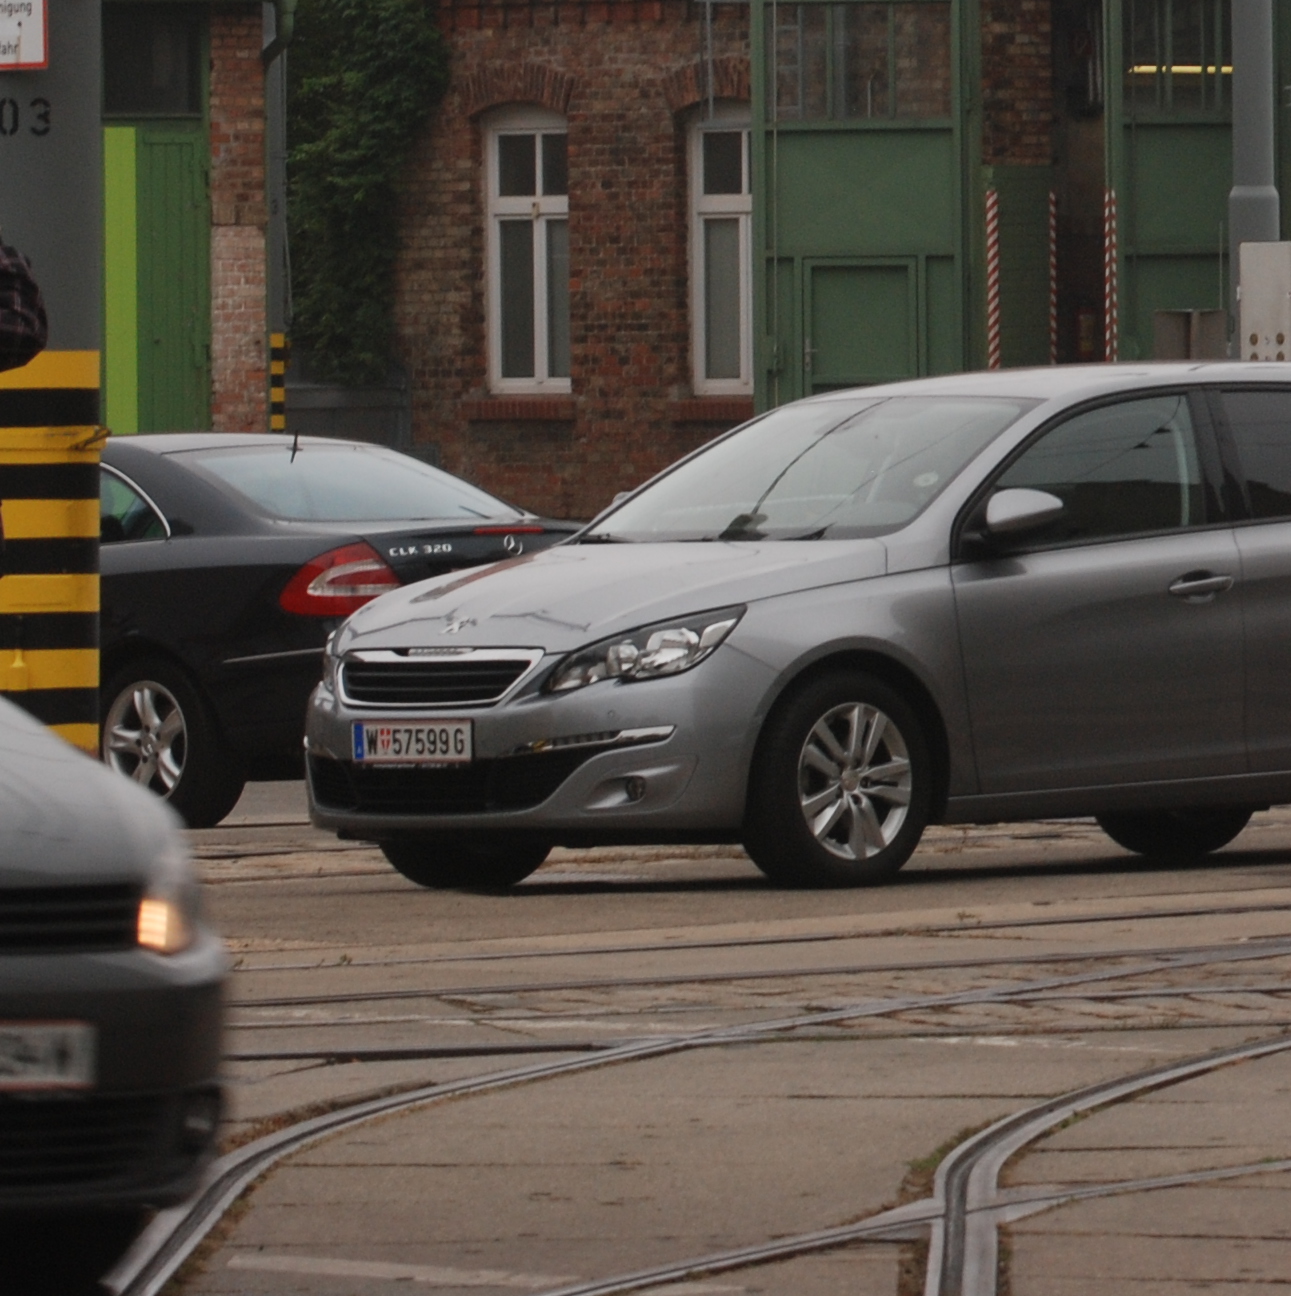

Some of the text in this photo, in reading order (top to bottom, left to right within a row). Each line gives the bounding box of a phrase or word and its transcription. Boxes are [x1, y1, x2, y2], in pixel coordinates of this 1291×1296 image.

[389, 543, 452, 557] CLK 320
[365, 728, 378, 755] W
